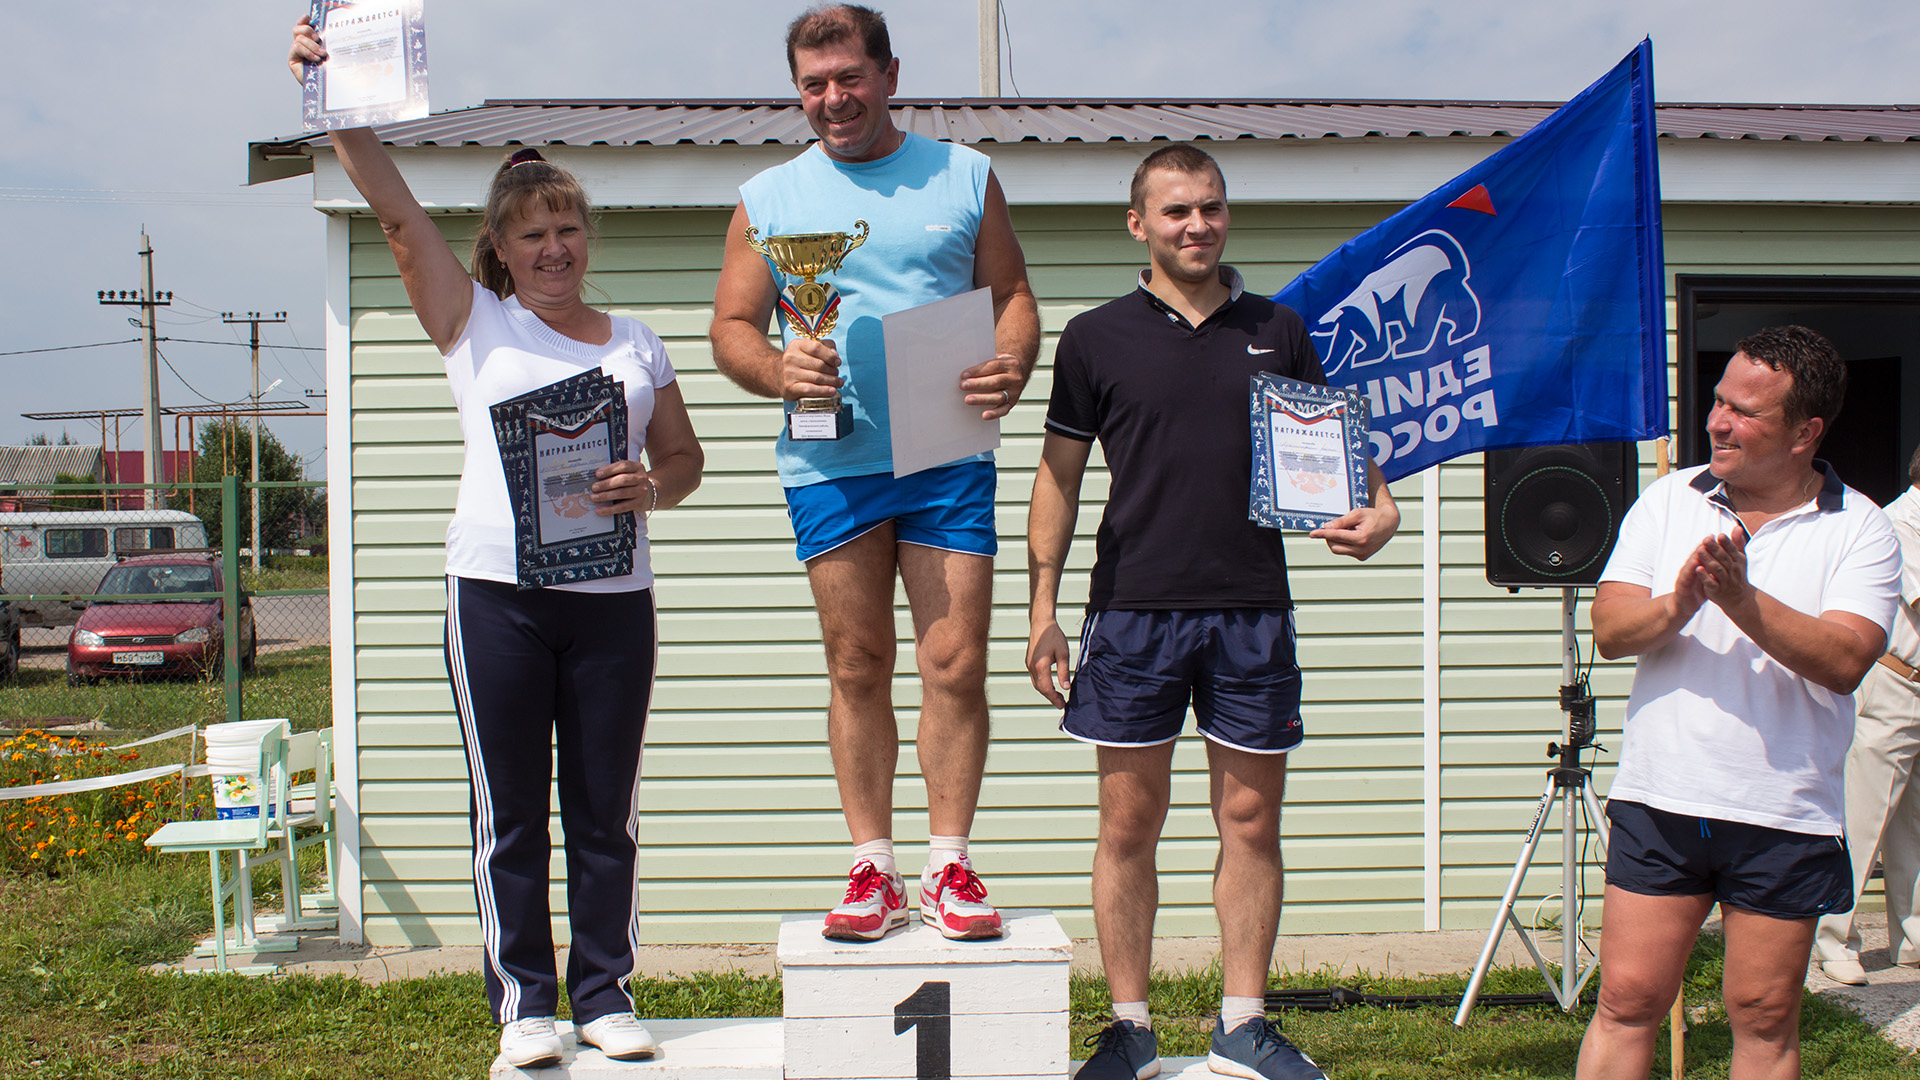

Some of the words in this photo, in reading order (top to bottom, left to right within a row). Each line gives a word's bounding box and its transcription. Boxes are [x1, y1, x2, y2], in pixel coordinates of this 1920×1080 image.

[329, 10, 400, 29] НАГРАЖДАЕТСЯ
[1271, 399, 1341, 418] ГРАМОТА
[535, 409, 607, 432] ГРАМОТА
[1274, 425, 1341, 439] НАГРАЖДАЕТСЯ
[539, 439, 607, 457] НАГРАЖДАЕТСЯ
[894, 981, 950, 1080] 1
